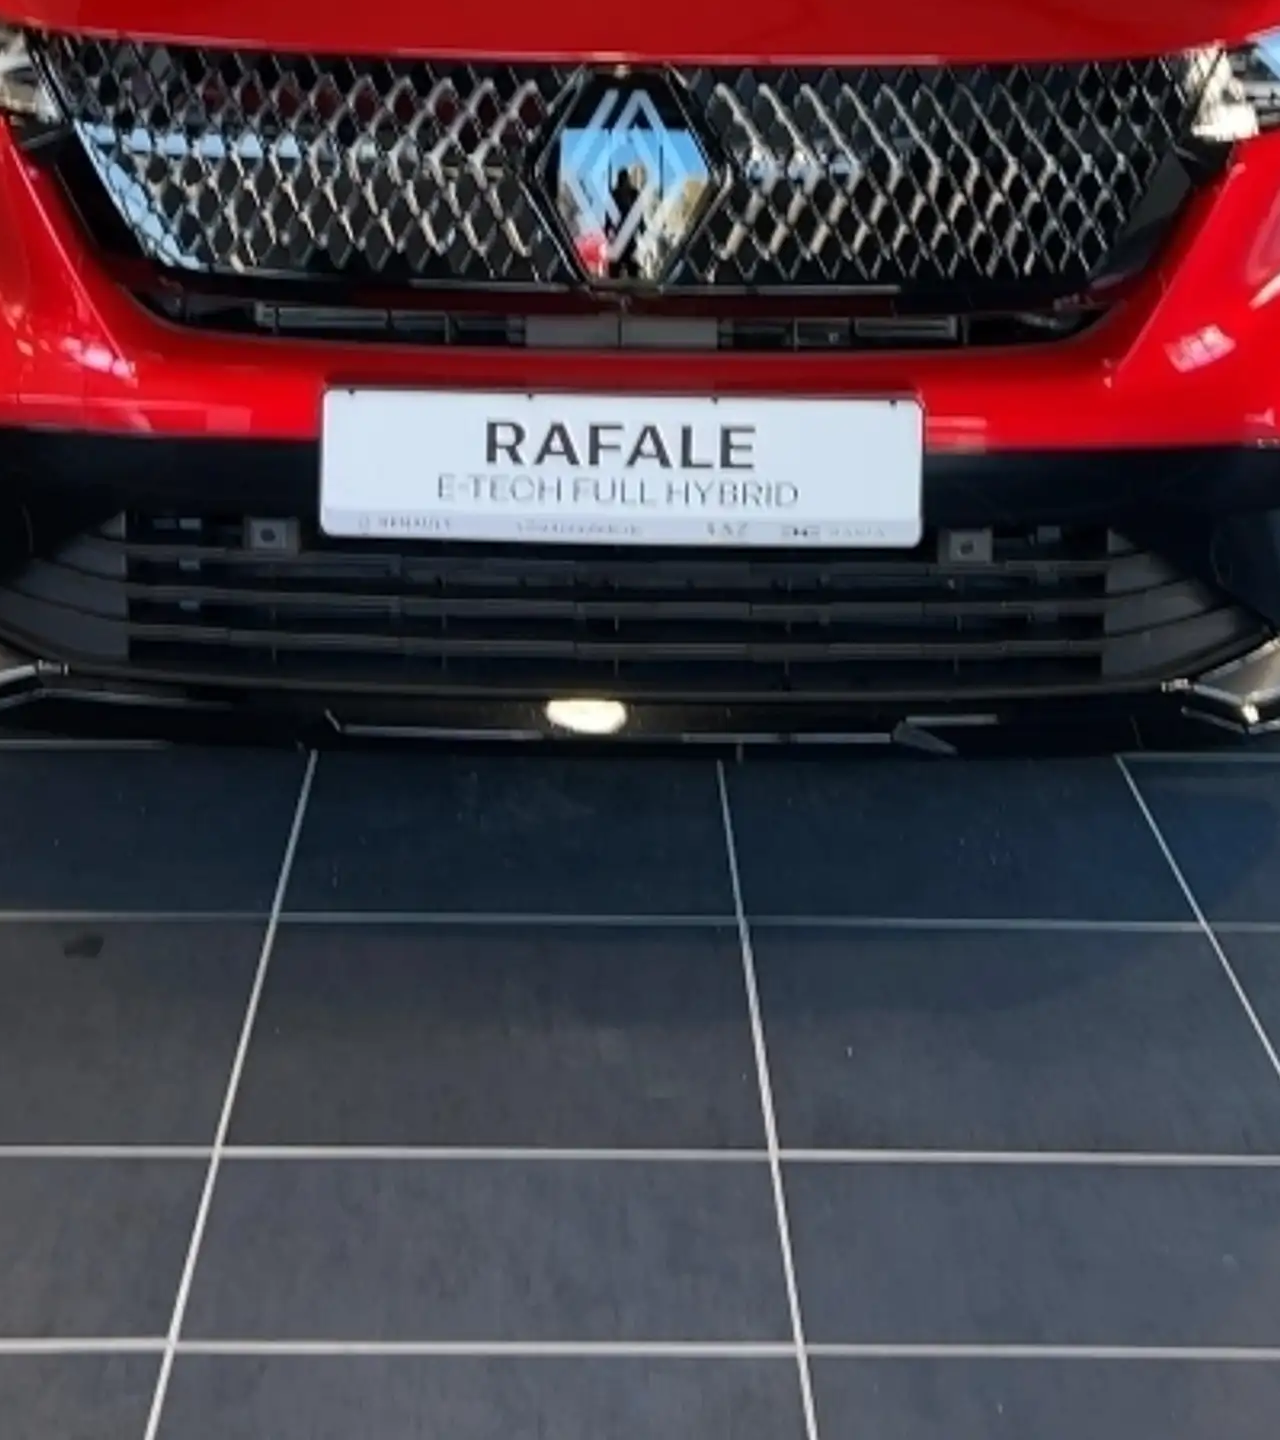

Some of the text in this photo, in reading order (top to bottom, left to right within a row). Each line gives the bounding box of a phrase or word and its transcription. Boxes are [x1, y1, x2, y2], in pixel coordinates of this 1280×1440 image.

[485, 419, 757, 470] RAFALE
[437, 474, 800, 508] E-TECH FULL HYBRID
